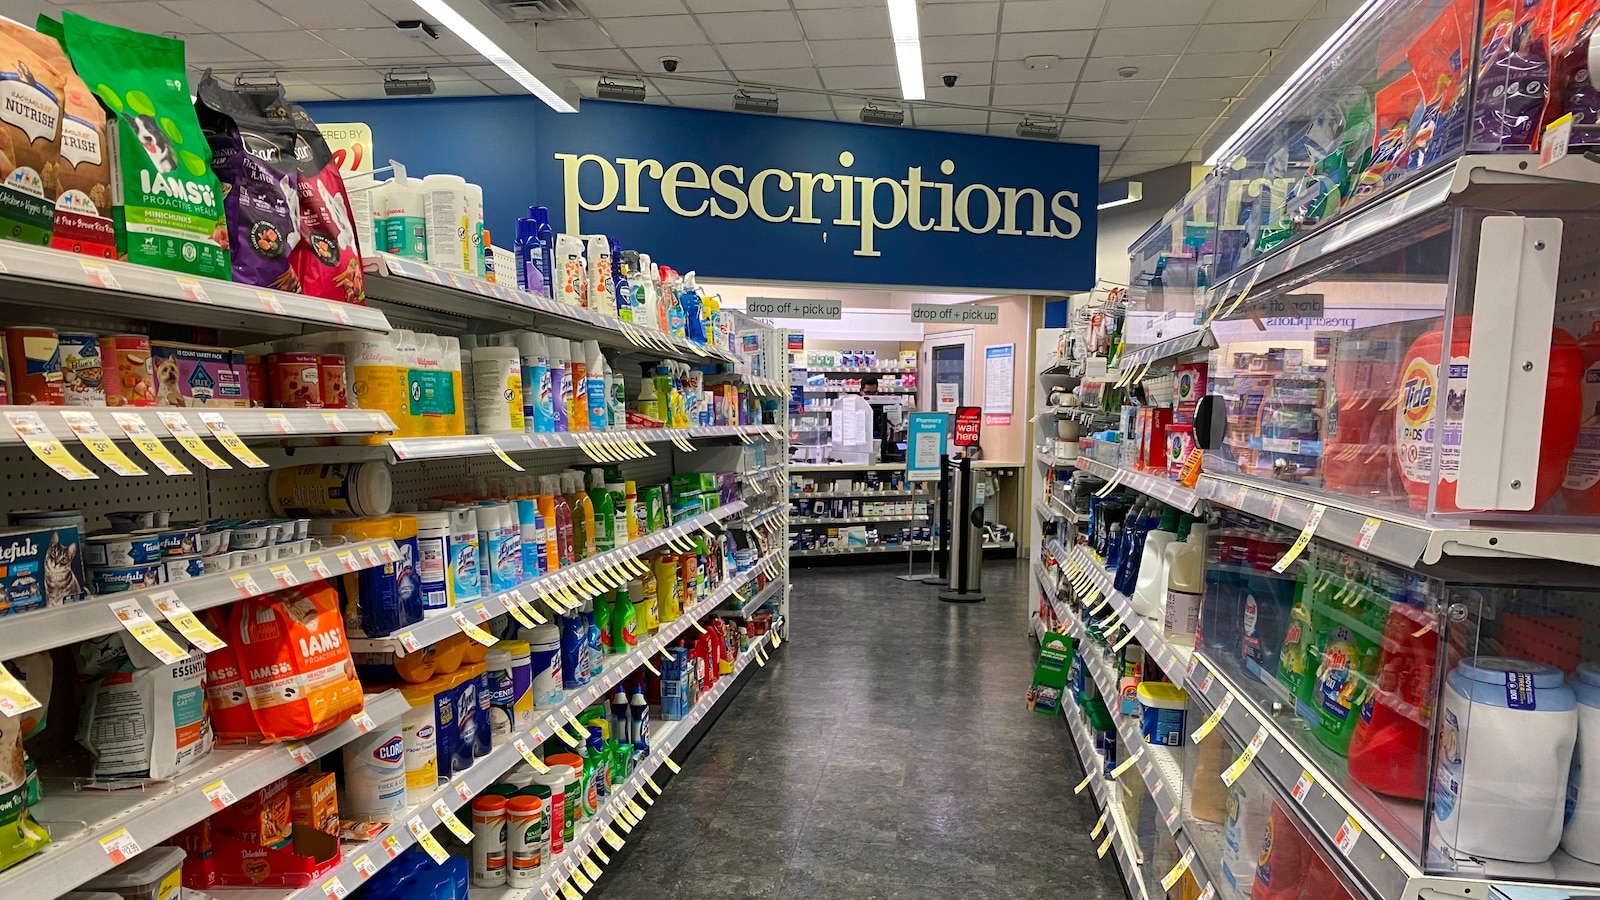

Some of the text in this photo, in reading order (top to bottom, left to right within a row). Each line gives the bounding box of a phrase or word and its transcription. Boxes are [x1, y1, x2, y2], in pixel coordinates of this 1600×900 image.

[5, 98, 56, 129] NUTRISH
[322, 130, 363, 140] ERED BY
[62, 136, 96, 153] TRISH
[140, 169, 202, 206] IAMS
[143, 195, 218, 218] PROACTIVE HEALTH
[554, 151, 1082, 257] prescriptions
[144, 210, 192, 224] MINICHUNKS
[748, 302, 774, 314] drop
[777, 302, 791, 313] off
[802, 304, 825, 316] pick
[826, 306, 840, 317] up
[913, 308, 937, 320] drop
[939, 308, 952, 319] off
[962, 310, 983, 321] pick
[984, 311, 997, 321] up
[1403, 377, 1432, 415] Tide
[958, 423, 978, 432] wait
[956, 431, 979, 441] here
[0, 538, 38, 562] tefuls
[102, 571, 143, 583] Tastefuls
[299, 628, 340, 658] IAMS
[304, 652, 336, 665] PROACTIVE
[250, 664, 280, 681] IAMS
[307, 670, 326, 679] HEALTHY
[274, 678, 294, 687] ADULT
[177, 691, 196, 700] INDOOR
[489, 688, 514, 699] SCENTI
[380, 741, 404, 759] CLORO
[378, 782, 393, 790] FREE
[241, 850, 268, 859] Delectables
[312, 871, 319, 879] 10
